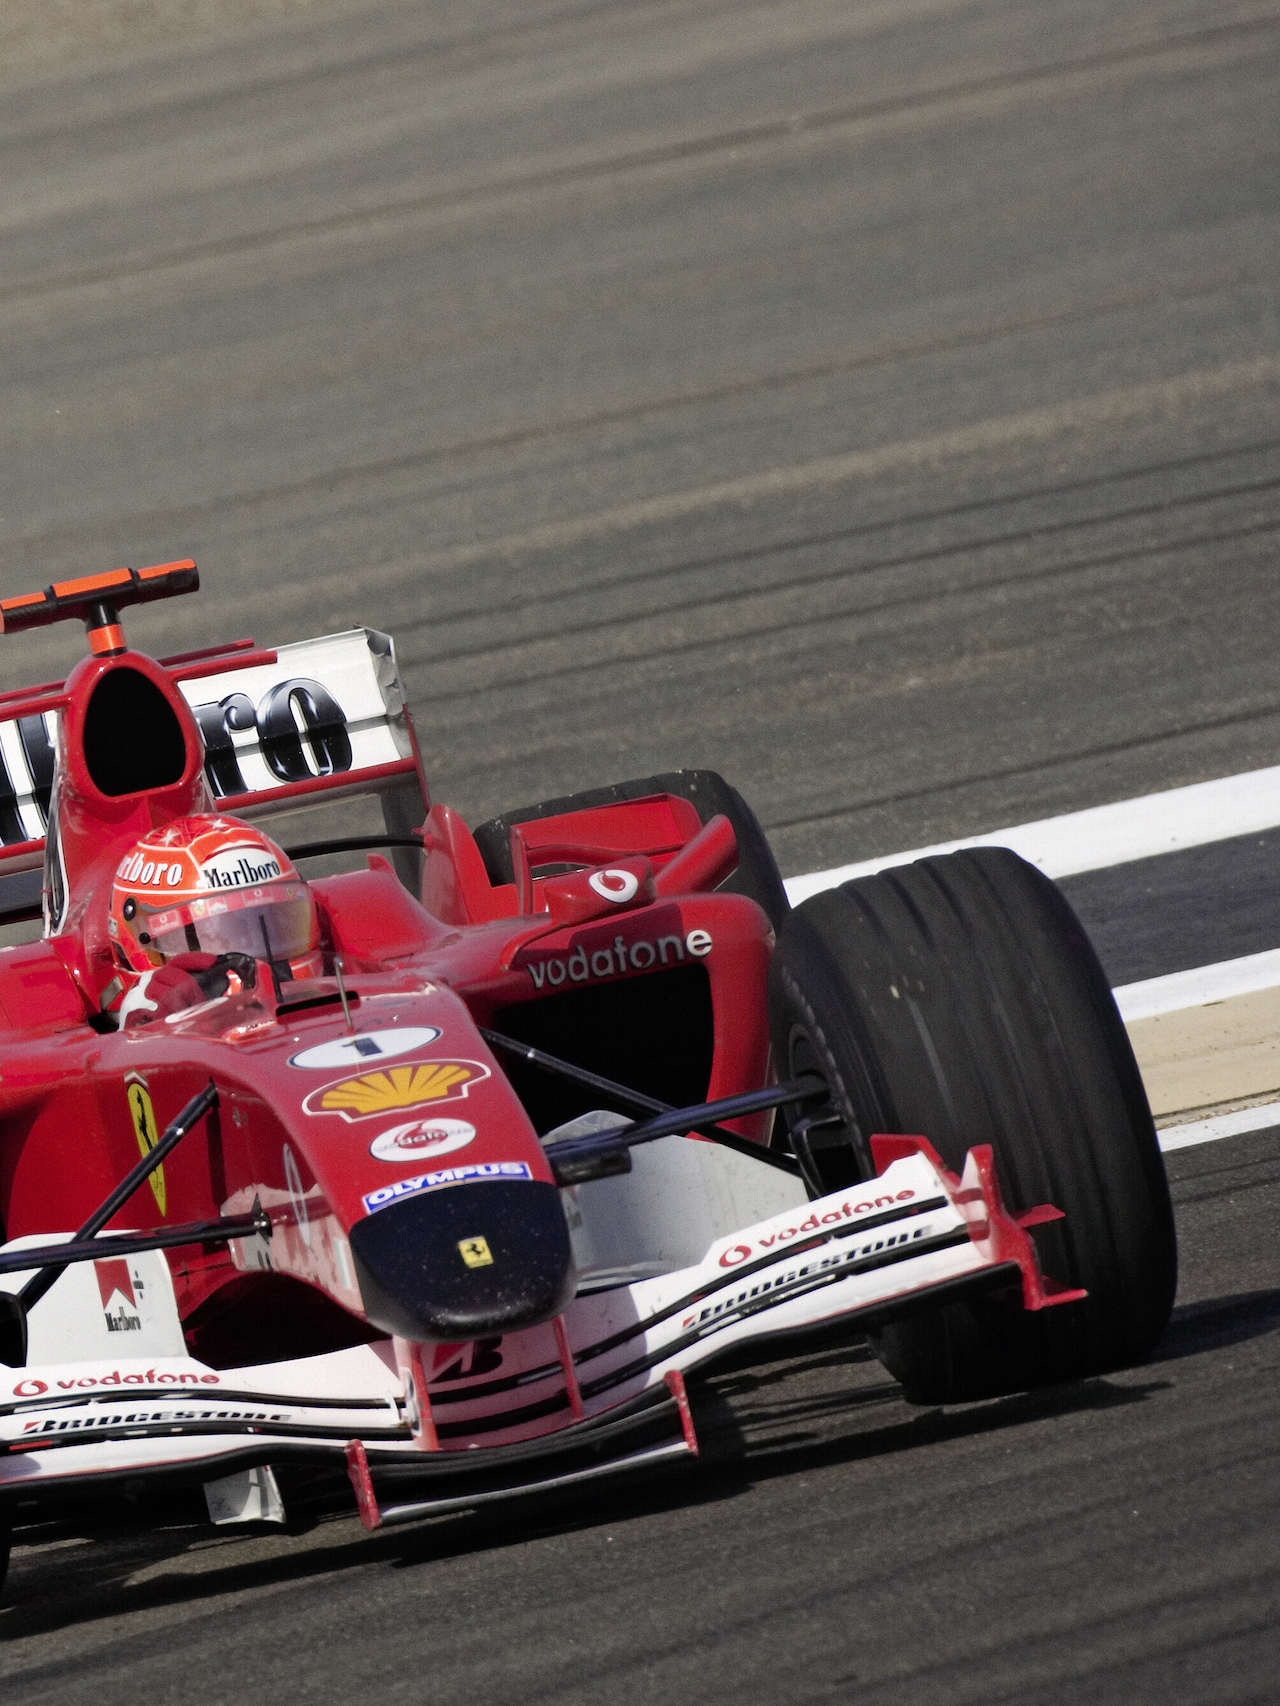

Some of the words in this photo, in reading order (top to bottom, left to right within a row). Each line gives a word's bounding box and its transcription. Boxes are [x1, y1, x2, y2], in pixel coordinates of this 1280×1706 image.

[116, 852, 183, 886] rlboro
[204, 859, 281, 889] Marlboro
[527, 929, 713, 989] vodafone
[341, 1037, 384, 1057] 1
[368, 1163, 525, 1205] OLYMPUS
[759, 1189, 915, 1247] vodafone
[682, 1225, 933, 1329] BRIDGESTONE
[57, 1369, 220, 1390] vodafone
[22, 1411, 292, 1434] BRIDGESTONE
